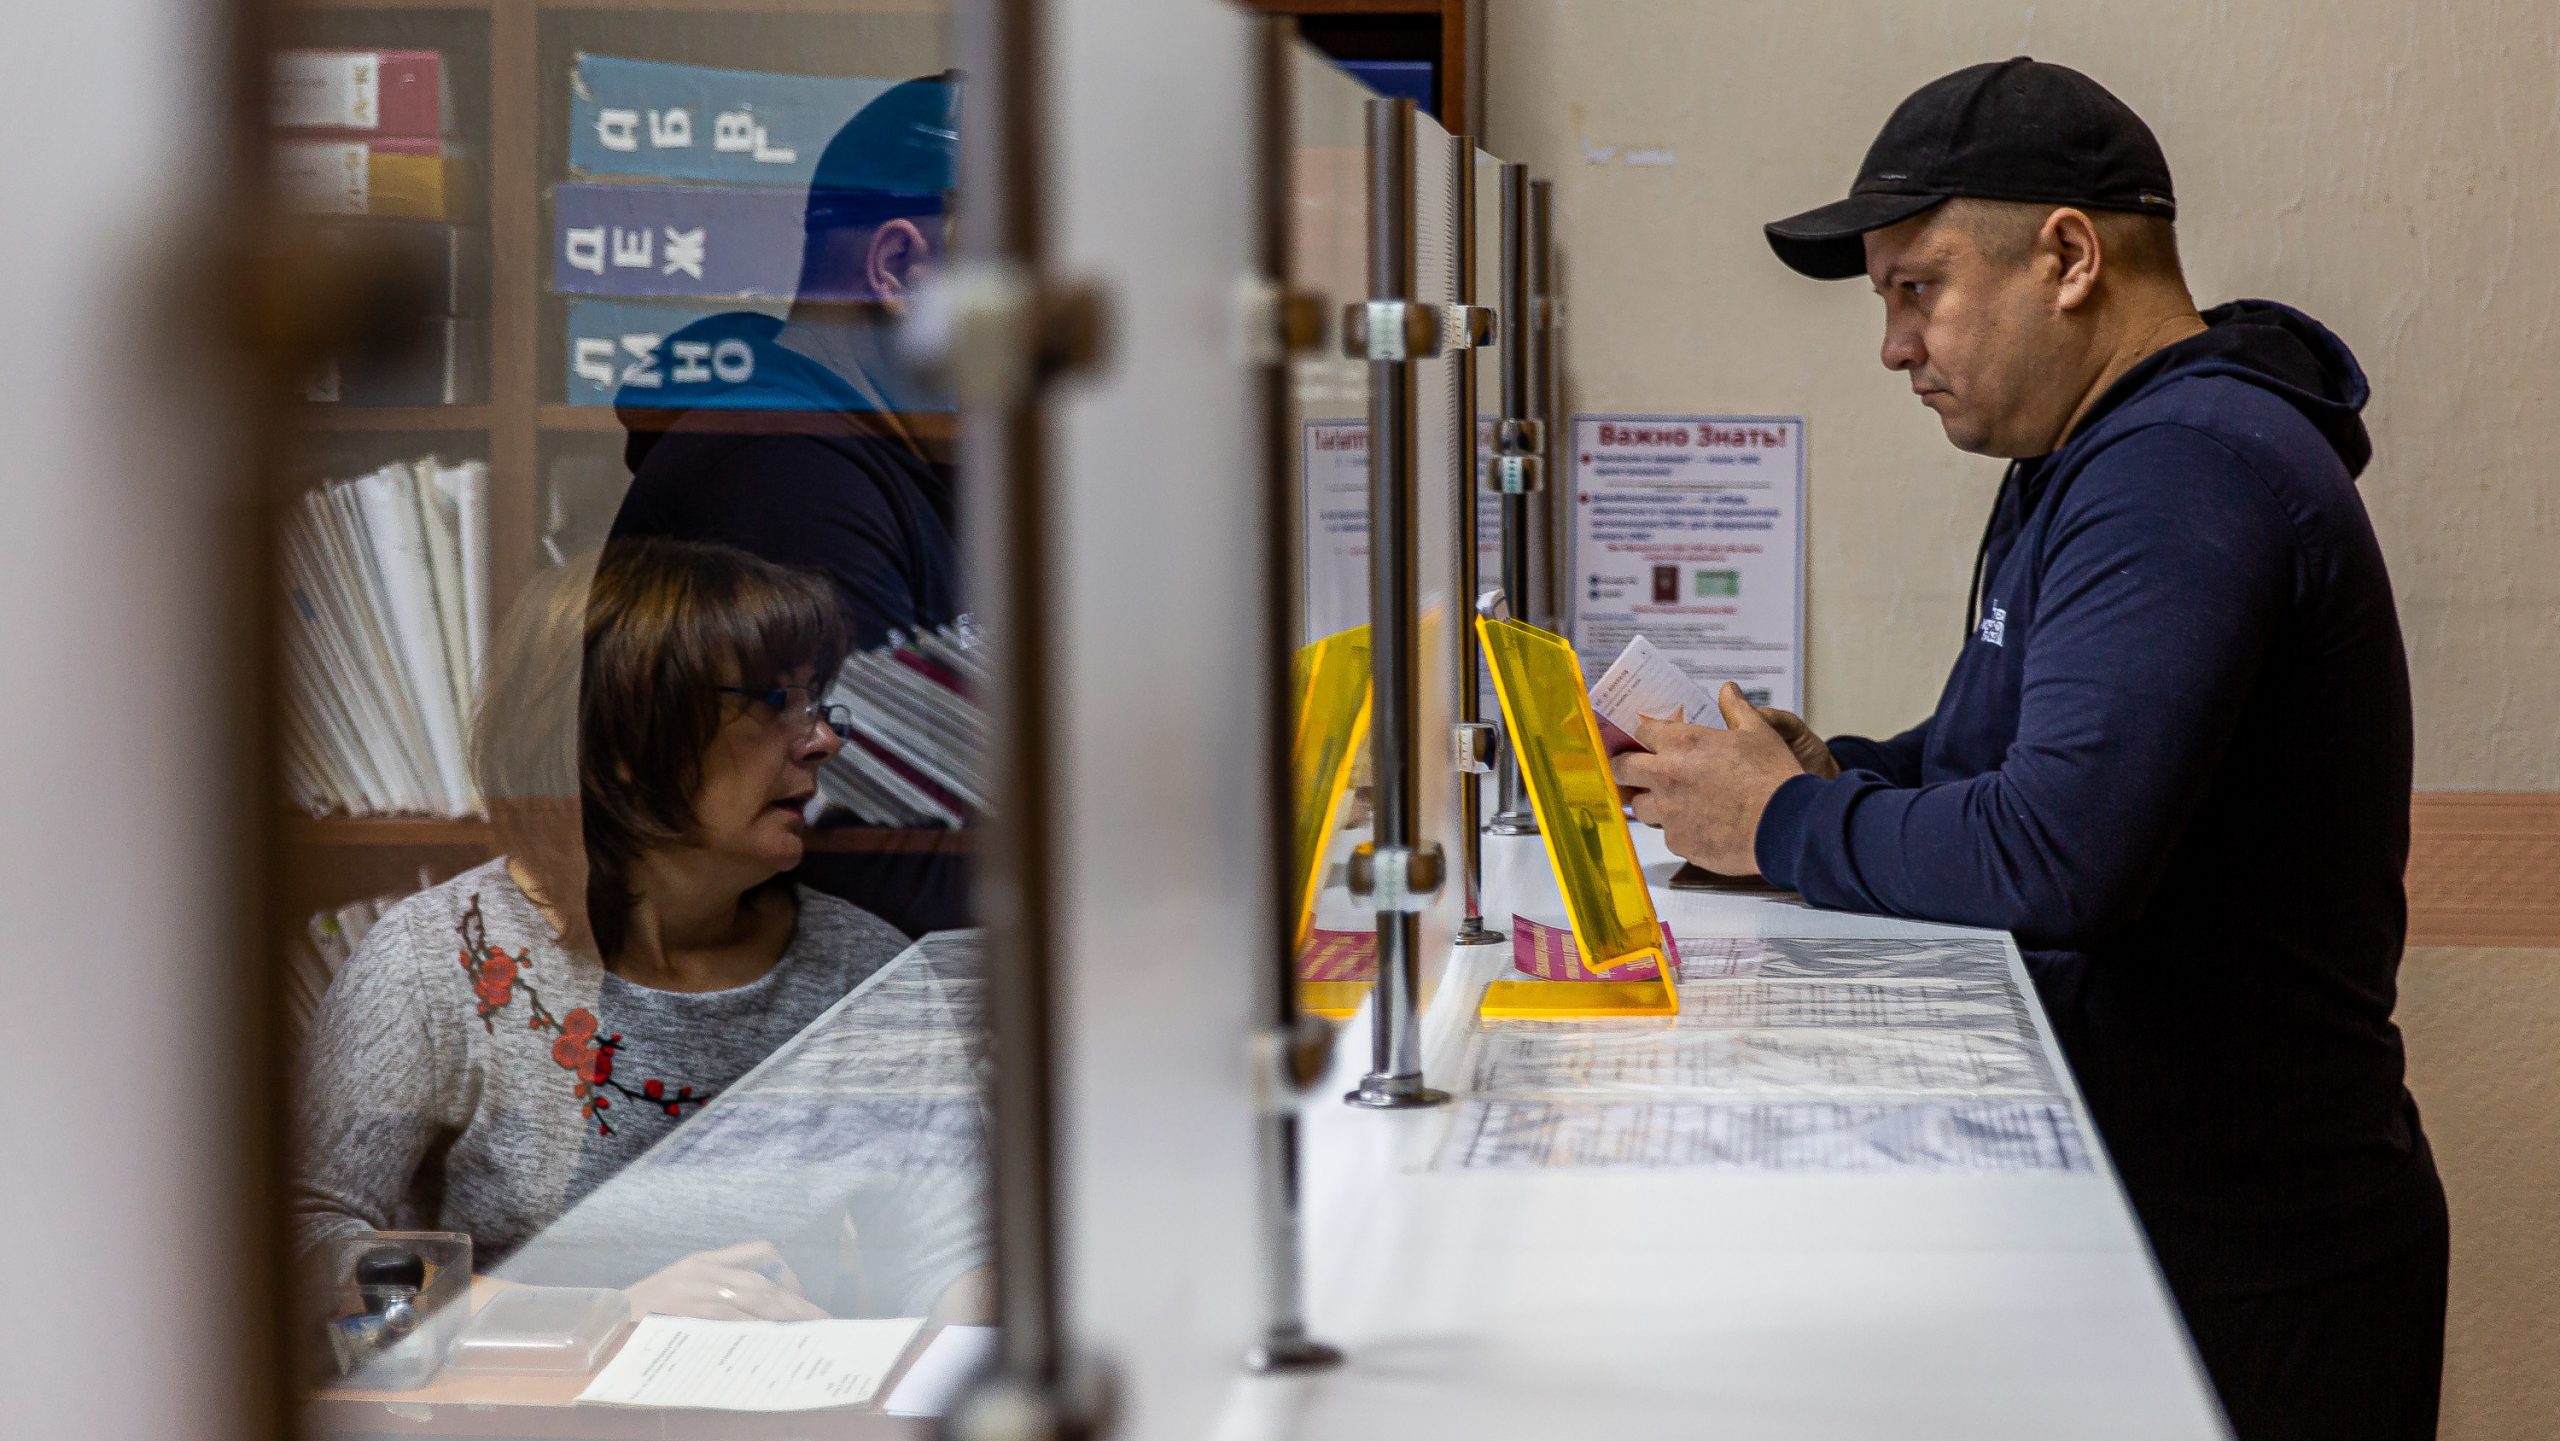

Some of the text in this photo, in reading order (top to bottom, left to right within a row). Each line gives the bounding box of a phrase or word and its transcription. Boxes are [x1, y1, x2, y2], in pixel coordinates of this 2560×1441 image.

[648, 108, 692, 148] Б
[714, 112, 754, 152] В
[753, 125, 797, 163] Г
[565, 226, 706, 280] Д Е Ж
[572, 332, 755, 389] Л М Н О
[1598, 423, 1787, 448] Важно Знать!
